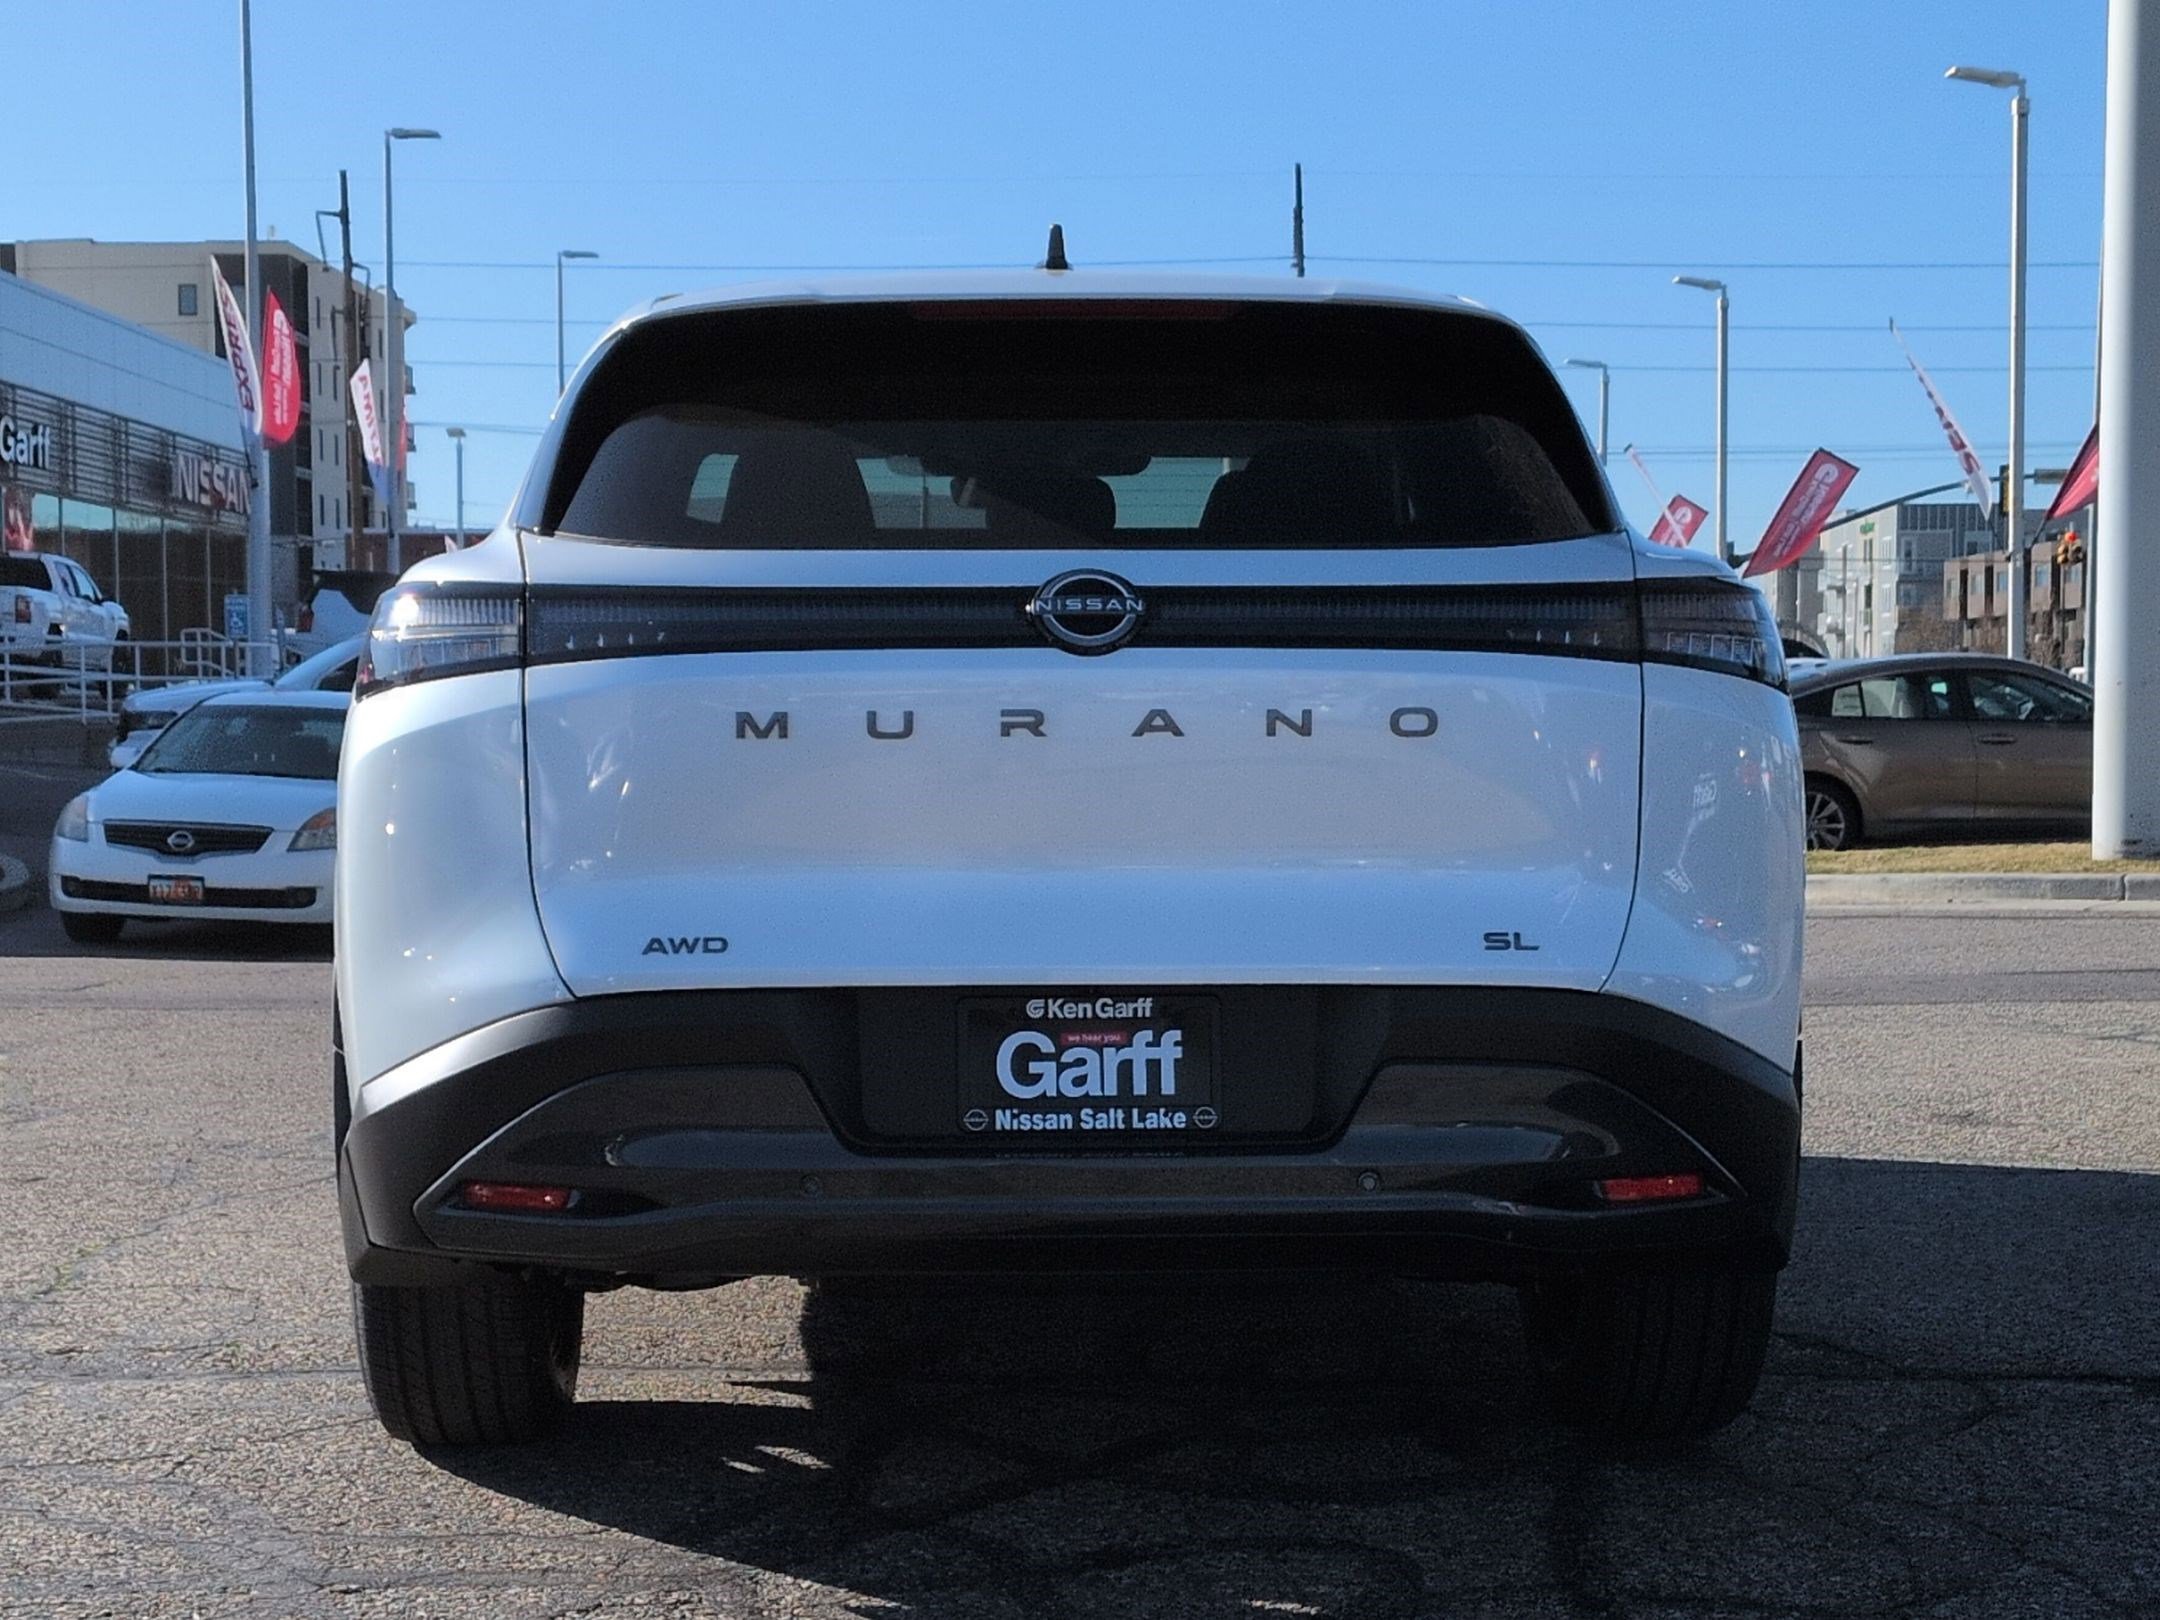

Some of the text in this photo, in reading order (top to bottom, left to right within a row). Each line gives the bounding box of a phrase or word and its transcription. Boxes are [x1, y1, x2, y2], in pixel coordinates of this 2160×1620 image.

[0, 415, 50, 468] Garff
[178, 453, 250, 514] NISSAN
[1035, 598, 1143, 612] NISSAN
[735, 708, 1439, 739] MURANO
[641, 937, 729, 955] AWD
[1483, 932, 1539, 951] SL
[1048, 997, 1153, 1018] Ken Garff
[996, 1029, 1183, 1099] Garff
[995, 1107, 1187, 1131] Nissan Salt Lake
